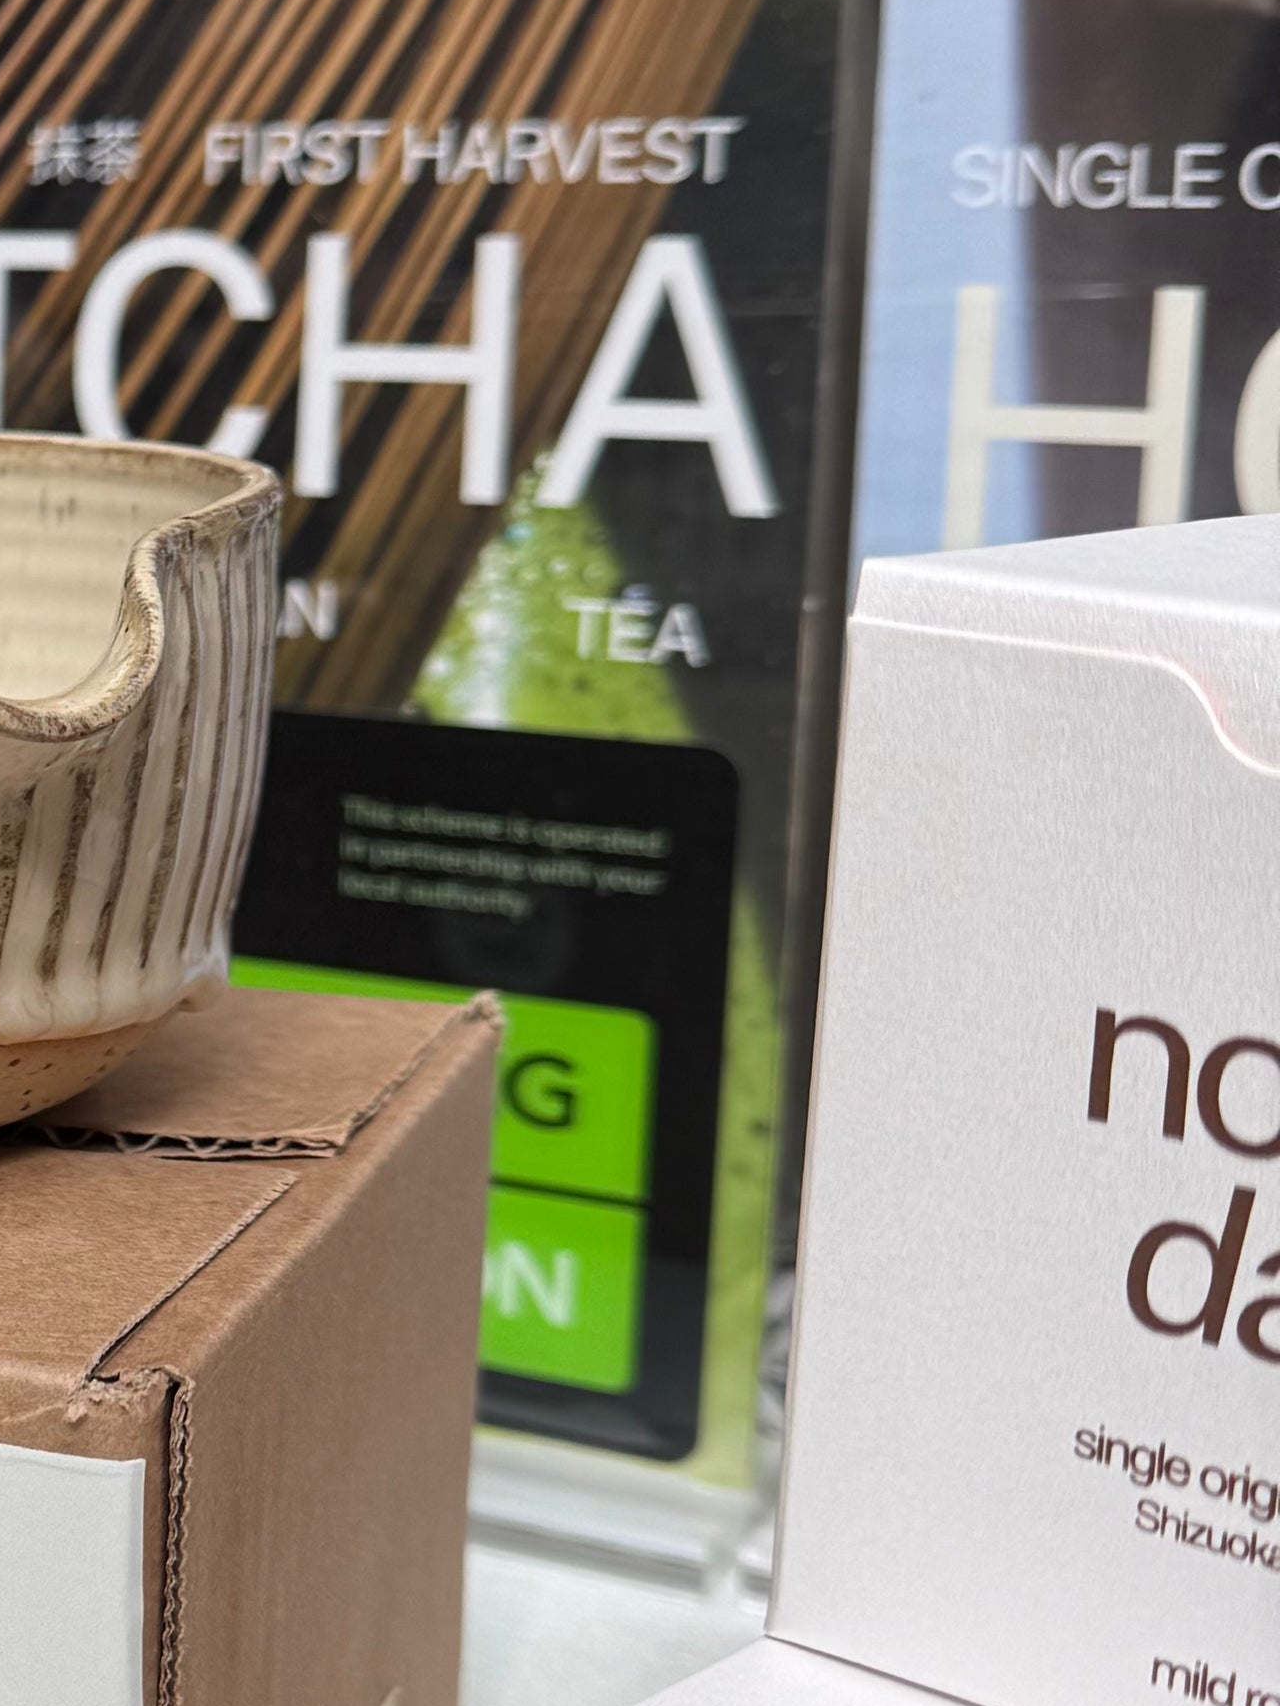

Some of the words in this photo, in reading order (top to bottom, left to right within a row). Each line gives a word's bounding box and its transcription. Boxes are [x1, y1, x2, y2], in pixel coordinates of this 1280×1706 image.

[202, 117, 390, 186] FIRST
[401, 115, 748, 186] HARVEST
[951, 141, 1228, 211] SINGLE
[944, 284, 1280, 551] H
[1074, 1423, 1190, 1487] single
[1199, 1463, 1280, 1523] orig
